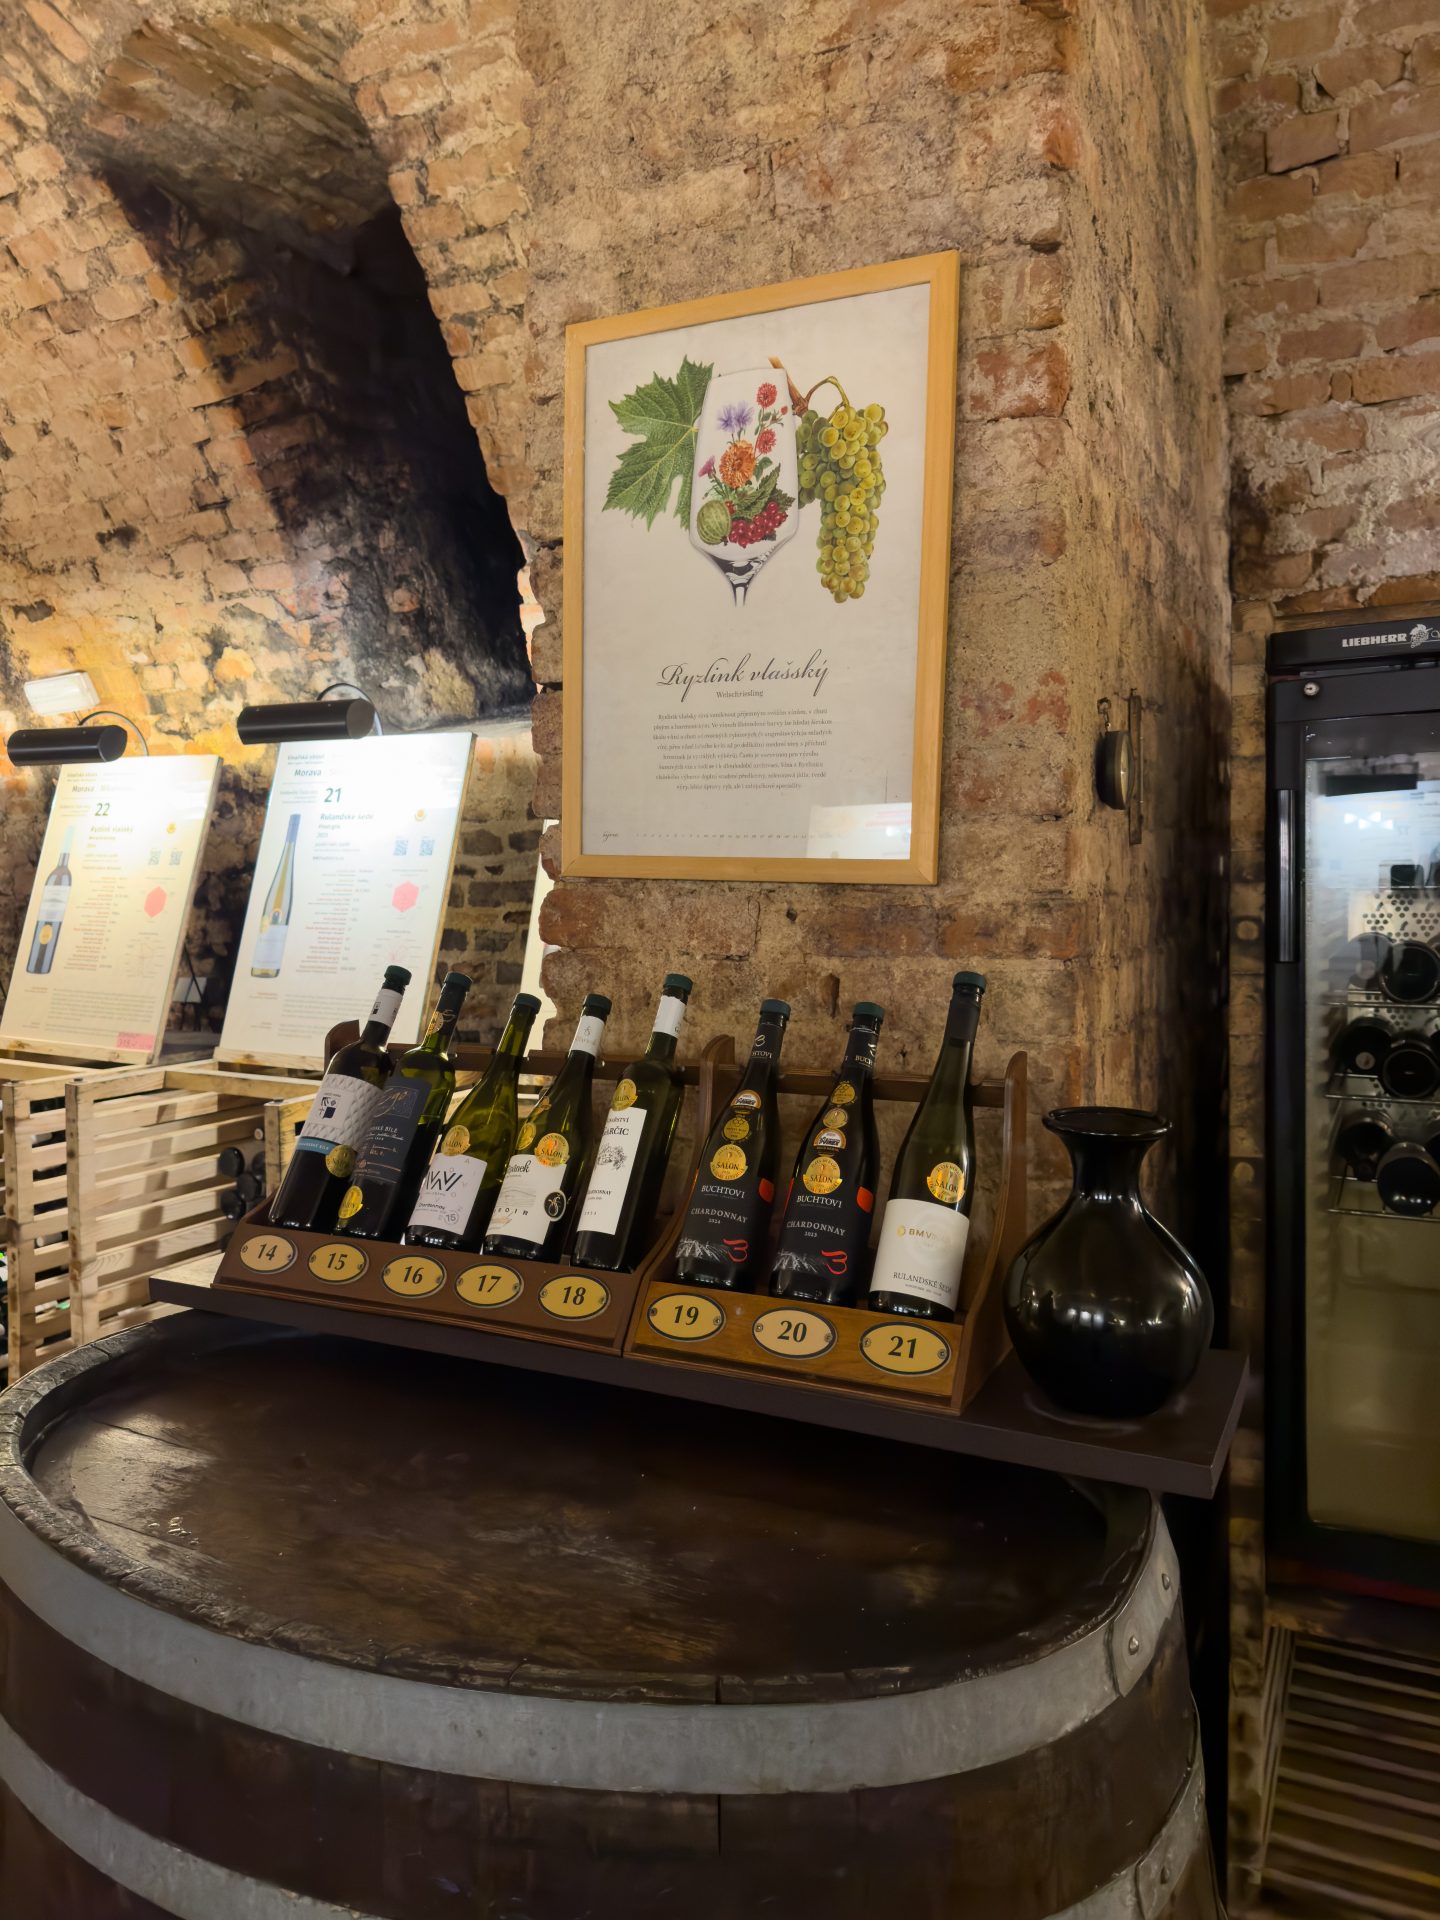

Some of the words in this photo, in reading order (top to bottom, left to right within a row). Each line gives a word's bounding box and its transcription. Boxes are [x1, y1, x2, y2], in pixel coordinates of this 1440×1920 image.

[1341, 633, 1407, 647] LIEBHERR
[655, 652, 752, 703] Ryzlink
[750, 649, 830, 698] vlašský
[294, 768, 322, 777] Morava
[324, 787, 342, 803] 21
[94, 802, 111, 816] 22
[541, 1148, 563, 1158] SALON
[716, 1161, 740, 1171] SALON
[809, 1173, 834, 1184] SALON
[935, 1179, 959, 1193] SALON
[701, 1184, 745, 1199] BUCHTOVI
[796, 1194, 842, 1209] BUCHTOVI
[445, 1213, 457, 1222] 15
[691, 1207, 748, 1224] CHARDONNAY
[786, 1220, 846, 1237] CHARDONNAY
[257, 1243, 278, 1261] 14
[327, 1252, 348, 1271] 15
[403, 1265, 424, 1285] 16
[477, 1274, 502, 1293] 17
[893, 1271, 938, 1289] RULANDSKÉ
[562, 1286, 587, 1306] 18
[674, 1304, 699, 1326] 19
[777, 1320, 807, 1343] 20
[888, 1335, 917, 1359] 21
